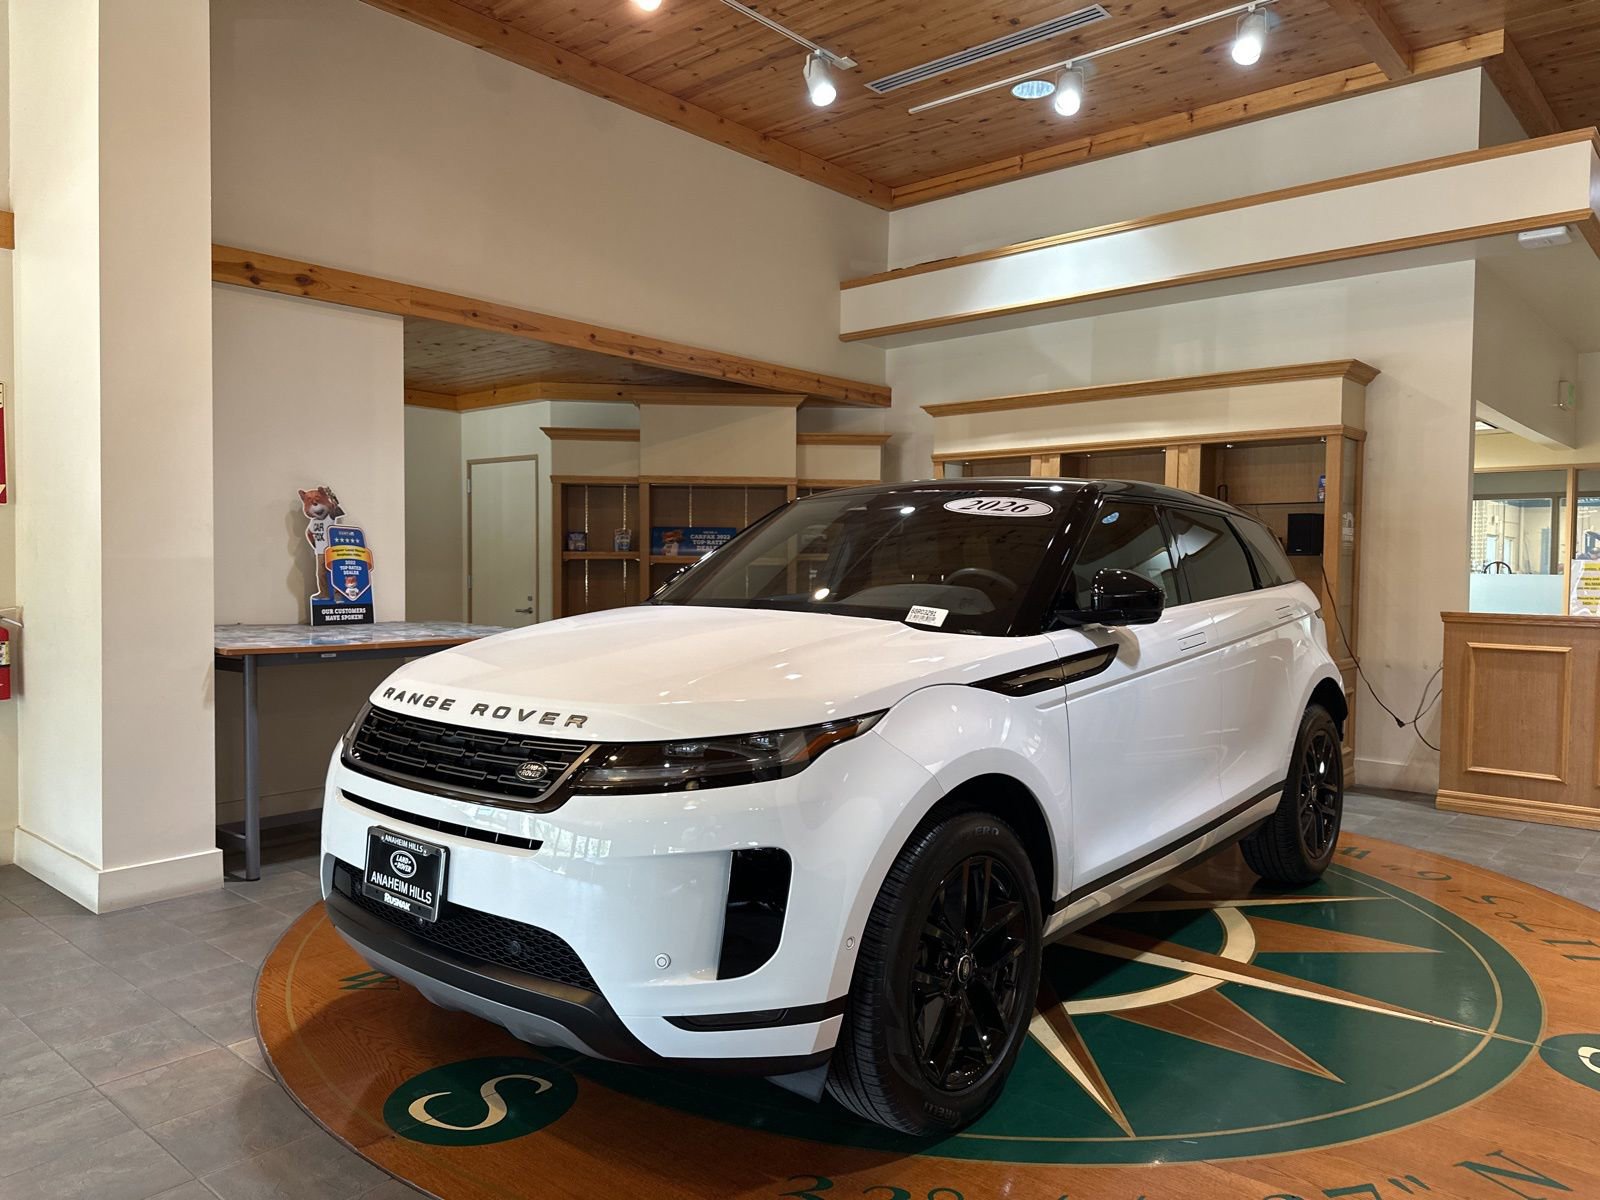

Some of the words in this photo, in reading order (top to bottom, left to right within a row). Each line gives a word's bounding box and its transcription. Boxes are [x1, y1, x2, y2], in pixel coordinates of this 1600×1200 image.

[960, 500, 1031, 513] 2026
[383, 687, 456, 711] RANGE
[470, 703, 589, 729] ROVER
[384, 834, 408, 848] ANAHEIM
[408, 841, 423, 853] HILLS
[396, 854, 409, 864] LAND
[396, 863, 412, 873] ROVER
[370, 870, 408, 895] ANAHEIM
[409, 884, 433, 905] HILLS
[408, 1074, 553, 1131] S
